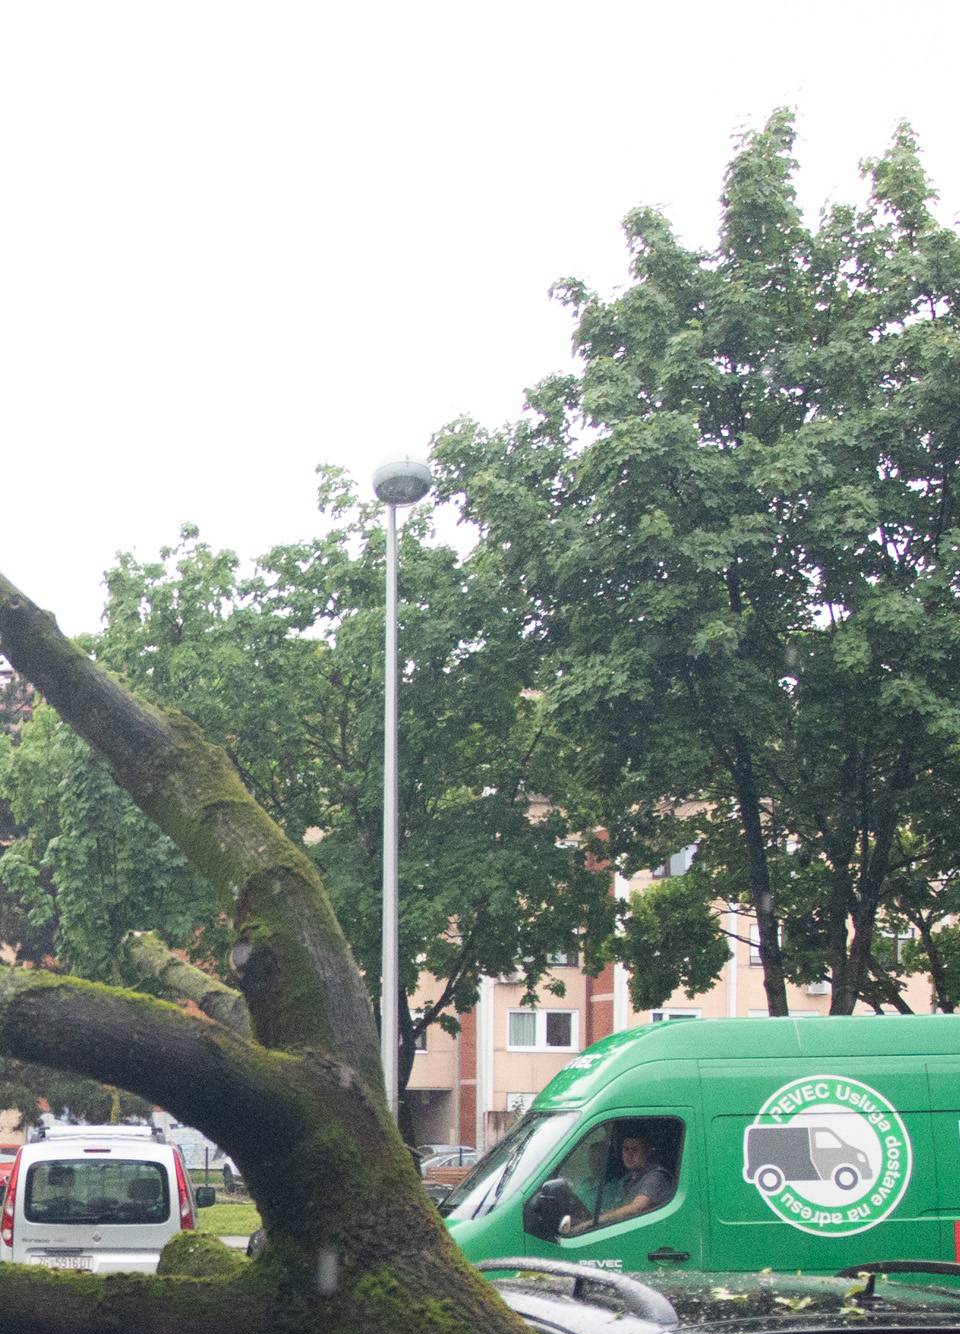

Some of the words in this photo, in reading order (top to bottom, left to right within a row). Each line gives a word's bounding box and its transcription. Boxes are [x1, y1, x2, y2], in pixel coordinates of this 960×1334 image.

[769, 1083, 830, 1123] PEVEC
[835, 1084, 892, 1133] Usluga
[870, 1135, 903, 1207] dostave
[779, 1192, 844, 1227] adresu
[846, 1206, 872, 1222] na
